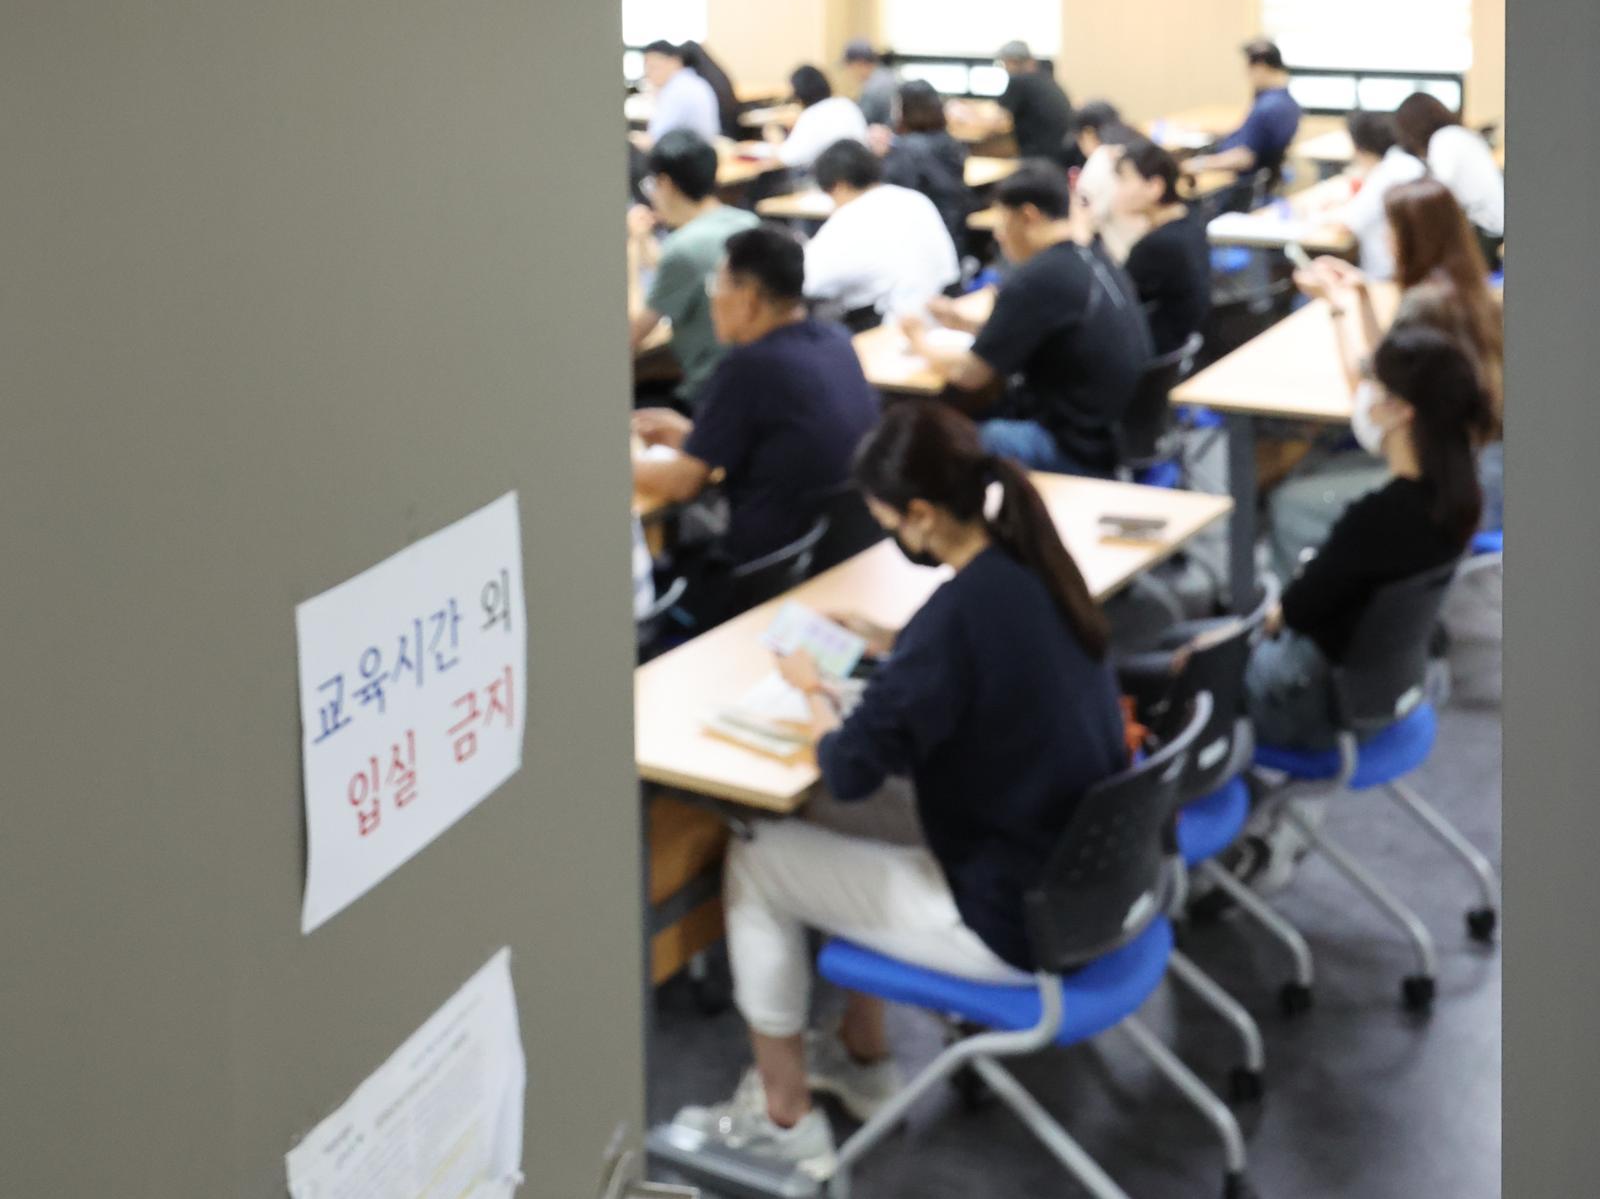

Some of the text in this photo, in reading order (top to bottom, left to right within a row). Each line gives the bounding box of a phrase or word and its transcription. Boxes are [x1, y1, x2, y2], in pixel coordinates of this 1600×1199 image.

[313, 568, 512, 745] 교육시간 외
[347, 664, 514, 837] 입실 금지
